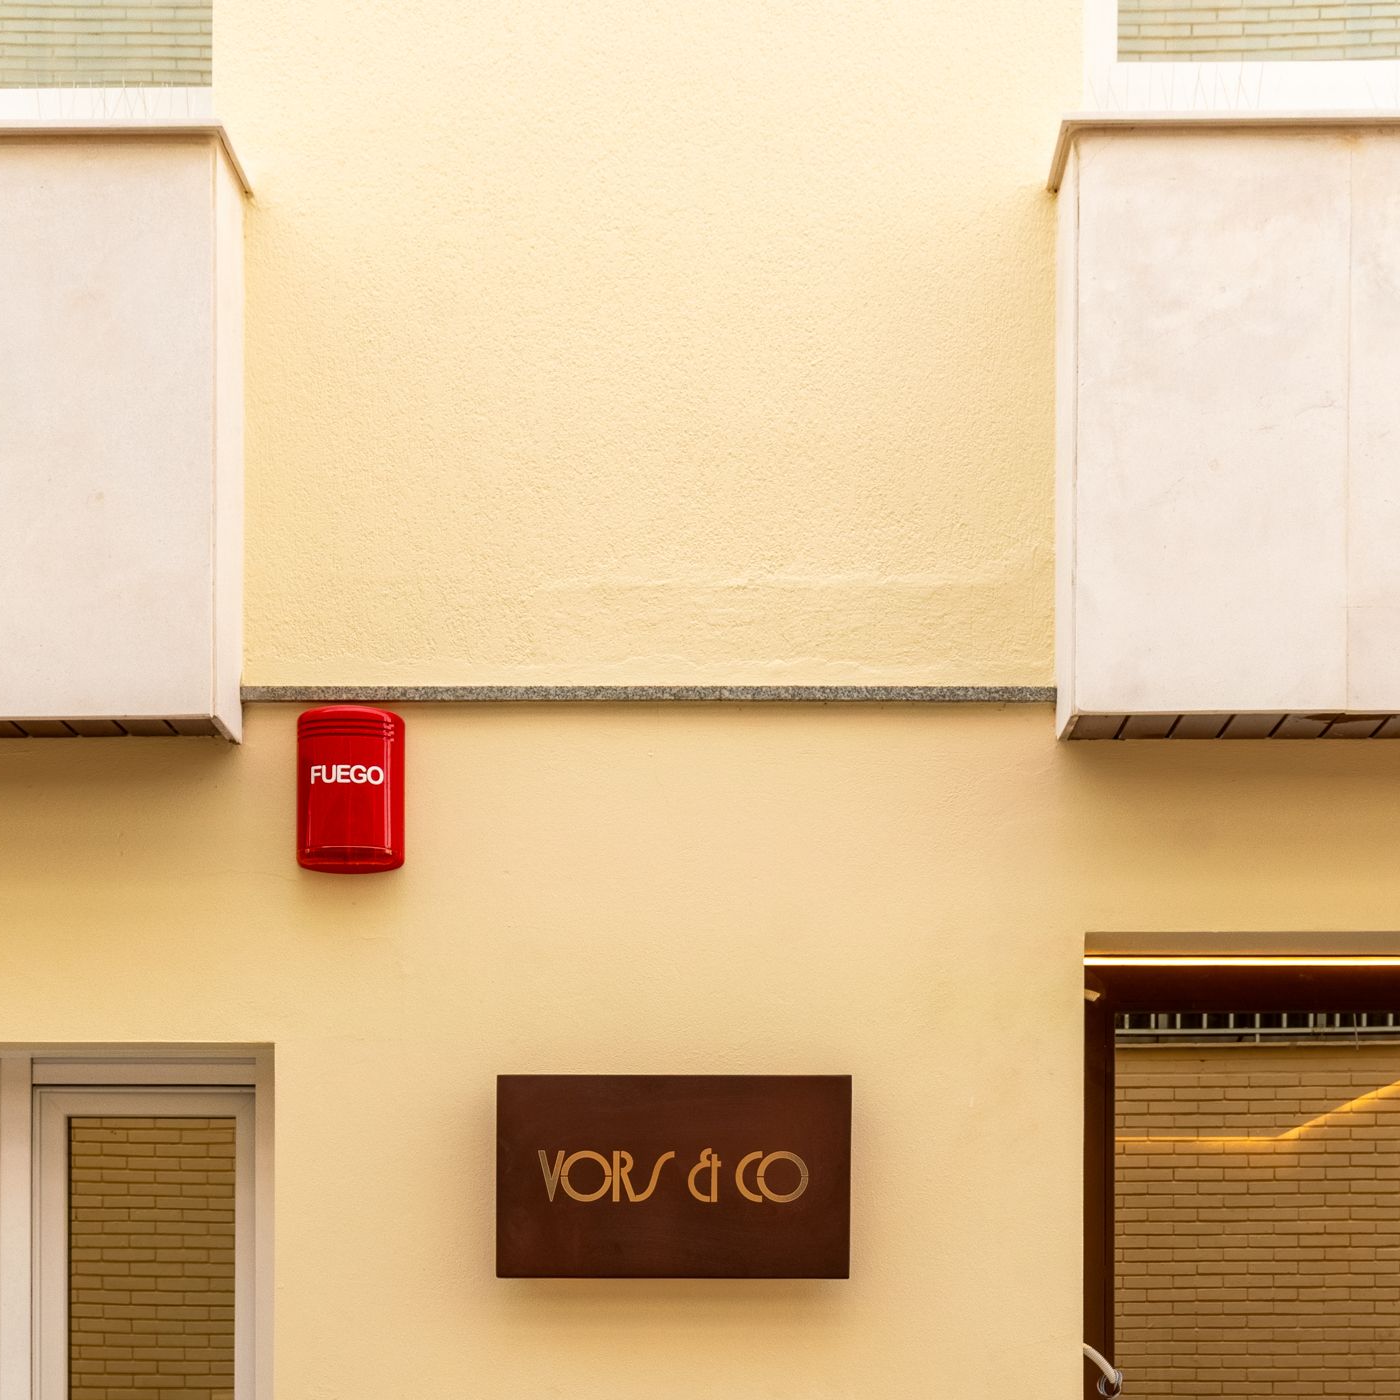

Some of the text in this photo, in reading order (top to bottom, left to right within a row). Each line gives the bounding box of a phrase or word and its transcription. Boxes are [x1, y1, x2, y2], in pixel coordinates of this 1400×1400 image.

[310, 764, 384, 785] FUEGO
[538, 1147, 809, 1203] VORS & CO
